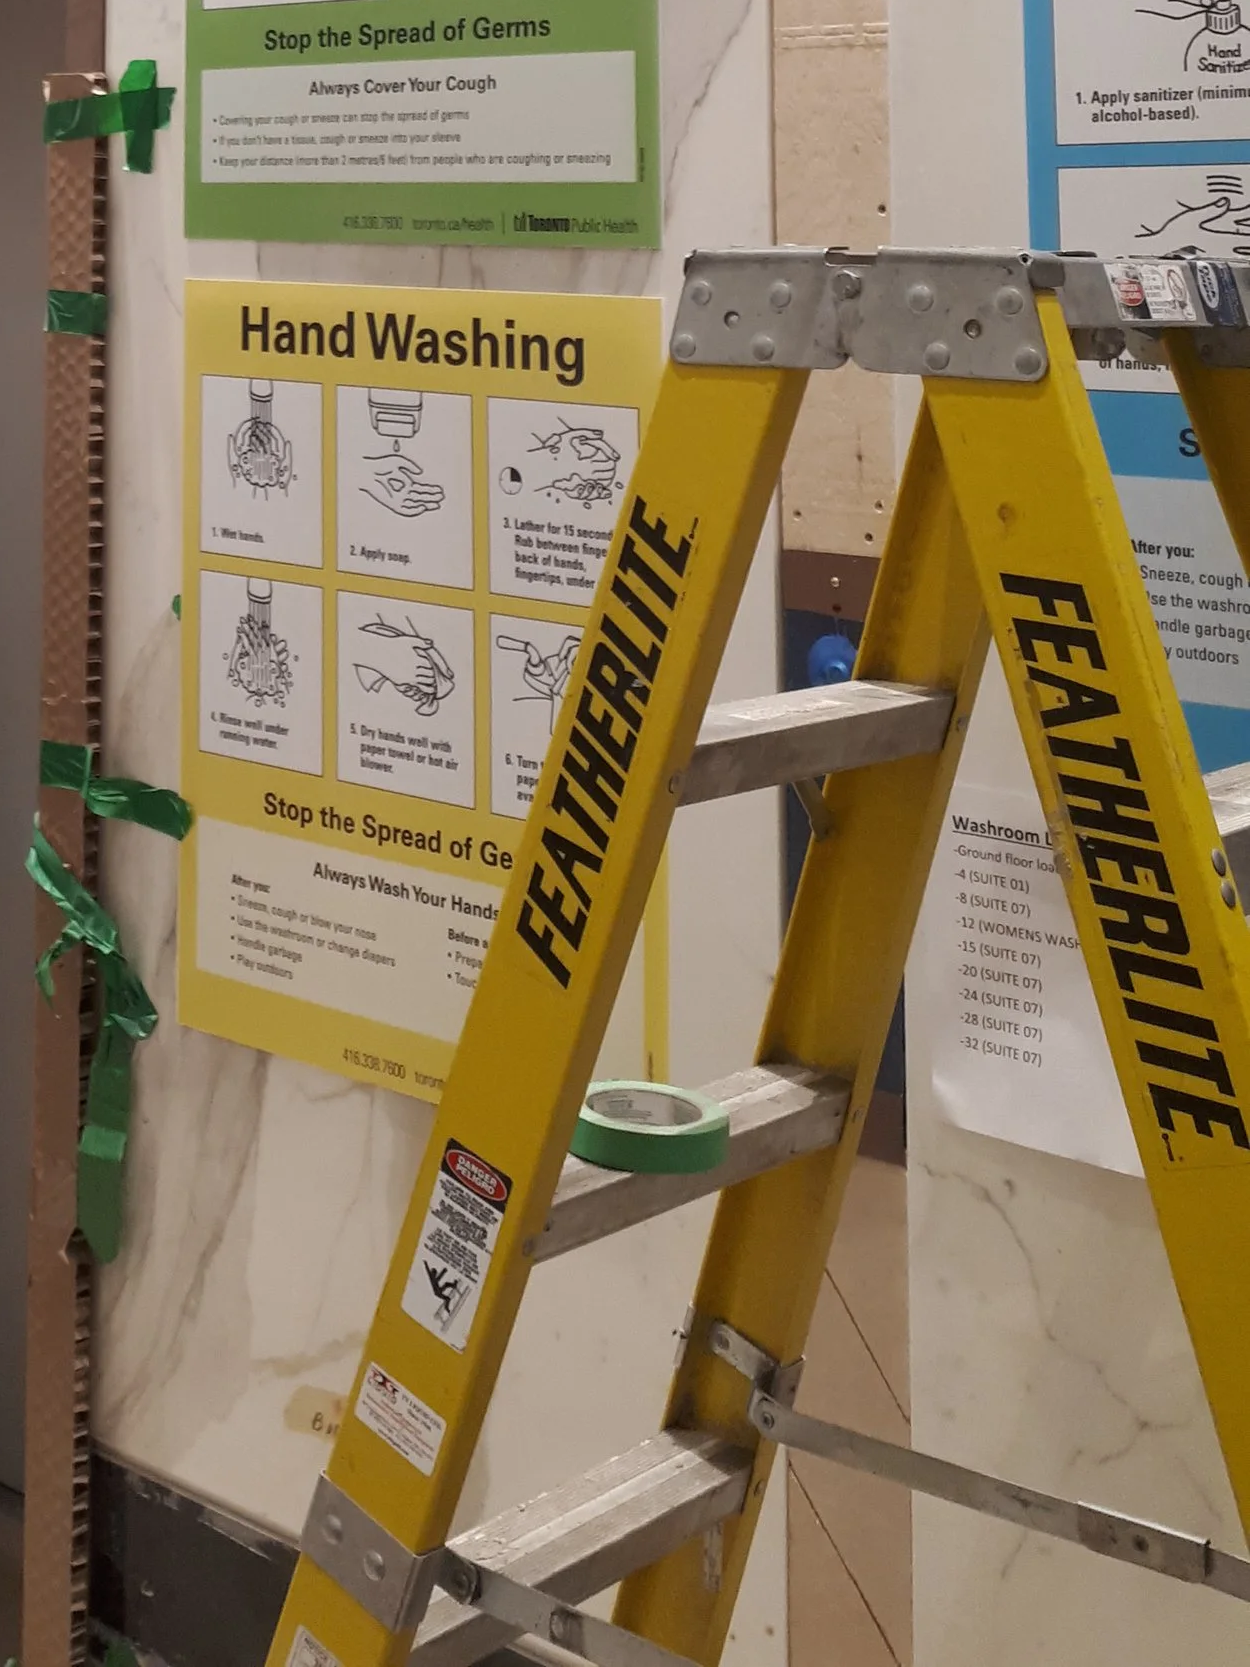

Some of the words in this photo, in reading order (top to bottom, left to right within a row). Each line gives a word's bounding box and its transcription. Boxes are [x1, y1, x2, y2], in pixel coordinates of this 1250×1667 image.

[264, 29, 312, 54] Stop
[318, 26, 351, 47] the
[358, 21, 436, 50] Spread
[443, 18, 466, 41] of
[472, 17, 551, 40] Germs
[1208, 43, 1242, 58] Hand
[1197, 57, 1250, 74] Sanitize
[309, 81, 360, 98] Always
[363, 79, 406, 94] Cover
[408, 77, 442, 92] Your
[445, 75, 497, 94] Cough
[1076, 92, 1087, 104] 1.
[1091, 90, 1130, 107] Apply
[1133, 87, 1194, 102] sanitizer
[1091, 105, 1199, 123] alcohol-based).
[241, 305, 355, 359] Hand
[366, 312, 585, 387] Washing
[503, 517, 511, 529] 3.
[515, 518, 545, 533] Lather
[547, 522, 561, 534] for
[564, 524, 575, 536] 15
[577, 529, 613, 541] second
[350, 545, 358, 557] 2.
[360, 546, 385, 562] Apply
[388, 550, 412, 565] soap.
[514, 535, 533, 547] Rub
[536, 538, 579, 553] between
[582, 543, 607, 559] finge
[1165, 545, 1195, 559] you:
[514, 551, 539, 564] back
[542, 555, 551, 566] of
[553, 556, 587, 572] hands,
[514, 567, 564, 586] fingertips,
[566, 577, 595, 589] under
[1140, 565, 1195, 585] Sneeze,
[1199, 574, 1243, 590] cough
[1170, 593, 1193, 609] the
[1197, 598, 1250, 615] washro
[1155, 619, 1190, 634] andle
[1175, 647, 1239, 665] outdoors
[350, 723, 358, 734] 5.
[360, 725, 376, 740] Dry
[378, 729, 406, 744] hands
[408, 736, 429, 748] well
[431, 740, 452, 753] with
[516, 495, 694, 990] FEATHERLITE
[360, 742, 386, 757] paper
[388, 748, 415, 762] towel
[416, 754, 426, 764] or
[429, 754, 443, 767] hot
[445, 758, 459, 771] air
[360, 757, 394, 774] blower.
[505, 754, 514, 766] 6.
[516, 755, 538, 770] Turn
[263, 792, 313, 828] Stop
[319, 806, 355, 834] the
[362, 814, 441, 854] Spread
[450, 837, 473, 861] of
[479, 840, 513, 870] Ge
[952, 815, 1040, 845] Washroom
[953, 844, 1002, 864] -Ground
[1005, 853, 1033, 869] floor
[1037, 858, 1055, 874] loa
[998, 571, 1250, 1151] FEATHERLITE
[313, 862, 366, 892] Always
[368, 874, 409, 901] Wash
[412, 885, 446, 909] Your
[451, 894, 499, 921] Hands
[955, 868, 966, 880] -4
[969, 870, 1007, 889] (SUITE
[1010, 879, 1030, 895] 01)
[955, 892, 968, 905] -8
[970, 894, 1008, 913] (SUITE
[1011, 902, 1031, 919] 07)
[448, 928, 480, 947] Before
[956, 916, 975, 930] -12
[979, 920, 1043, 943] (WOMENS
[1045, 933, 1081, 950] WASH
[455, 950, 483, 970] Prepa
[958, 940, 976, 954] -15
[980, 942, 1018, 963] (SUITE
[1021, 952, 1041, 970] 07)
[454, 971, 477, 989] Touc
[958, 964, 978, 978] -20
[981, 967, 1019, 987] (SUITE
[1022, 976, 1042, 994] 07)
[959, 988, 978, 1002] -24
[981, 991, 1020, 1011] (SUITE
[1023, 1001, 1043, 1019] 07)
[960, 1012, 979, 1026] -28
[982, 1015, 1020, 1035] (SUITE
[1023, 1025, 1043, 1043] 07)
[960, 1036, 979, 1050] -32
[982, 1039, 1019, 1060] (SUITE
[1022, 1050, 1042, 1068] 07)
[456, 1164, 495, 1196] PELIGRO
[457, 1155, 497, 1187] DANGER
